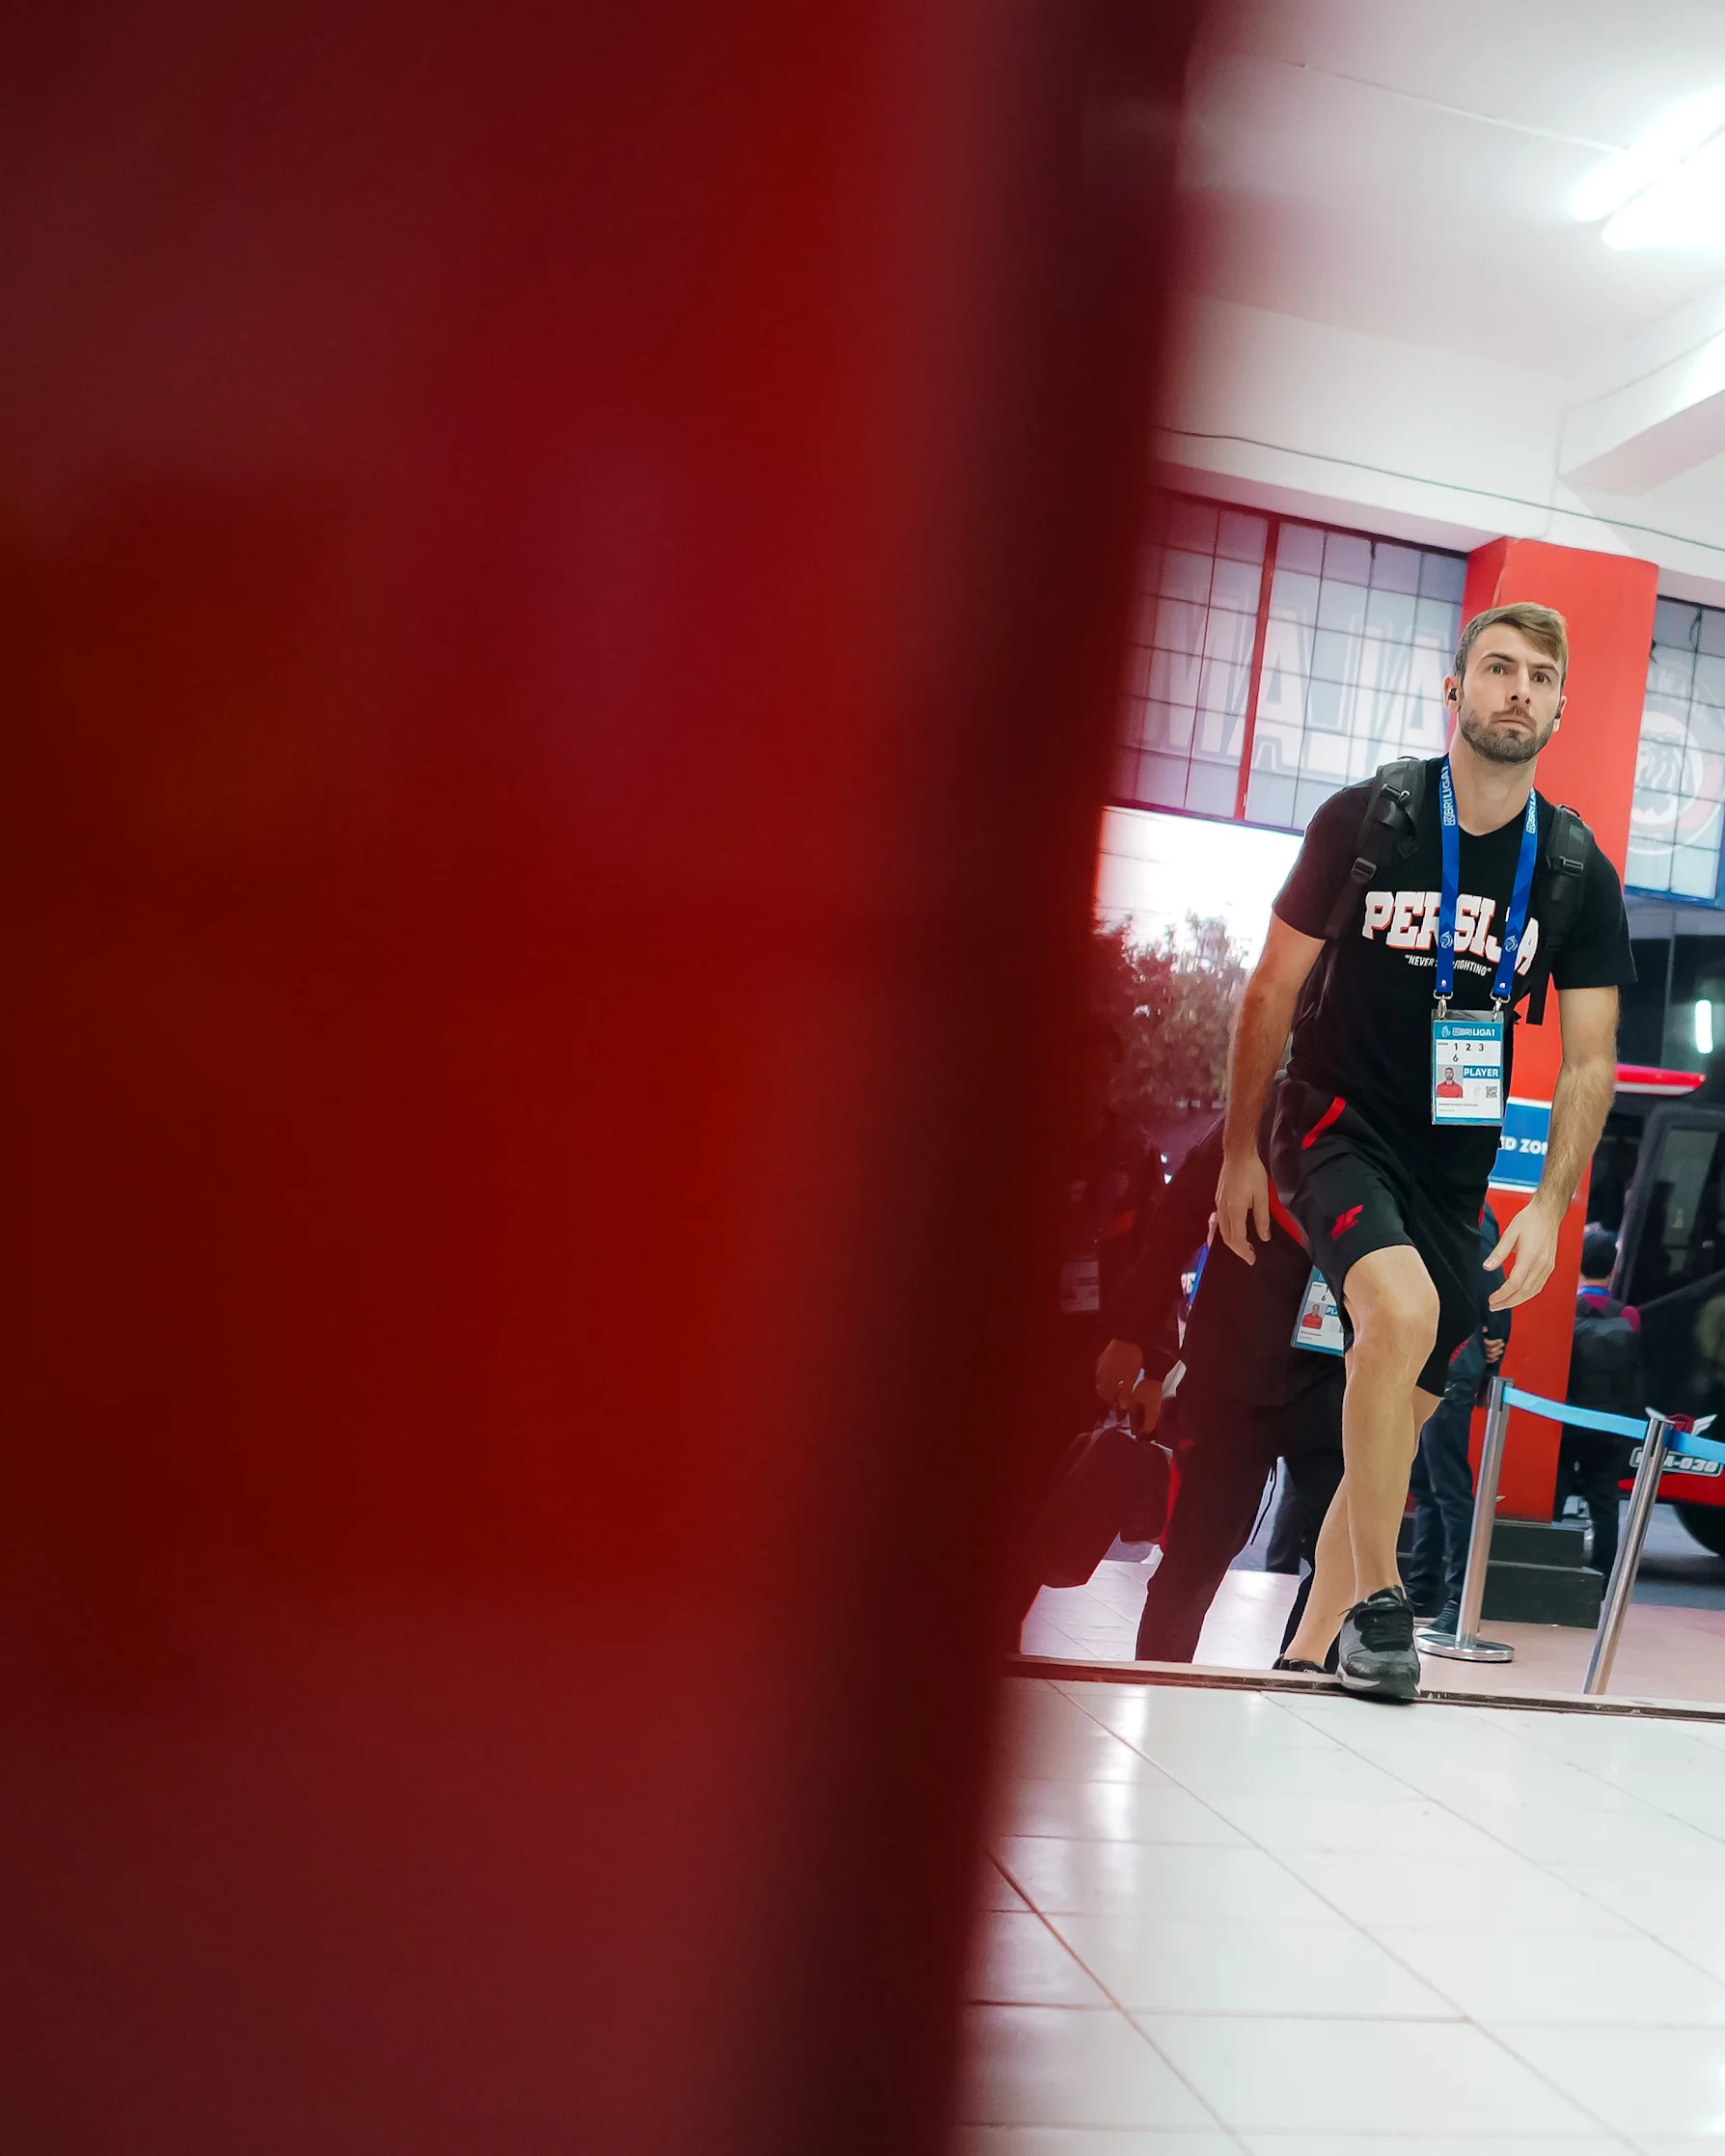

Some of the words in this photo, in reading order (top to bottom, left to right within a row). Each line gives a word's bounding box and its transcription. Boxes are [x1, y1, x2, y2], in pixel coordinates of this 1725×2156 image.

[1454, 1043, 1458, 1051] 1
[1465, 1043, 1471, 1051] 2
[1464, 1068, 1498, 1077] PLAYER
